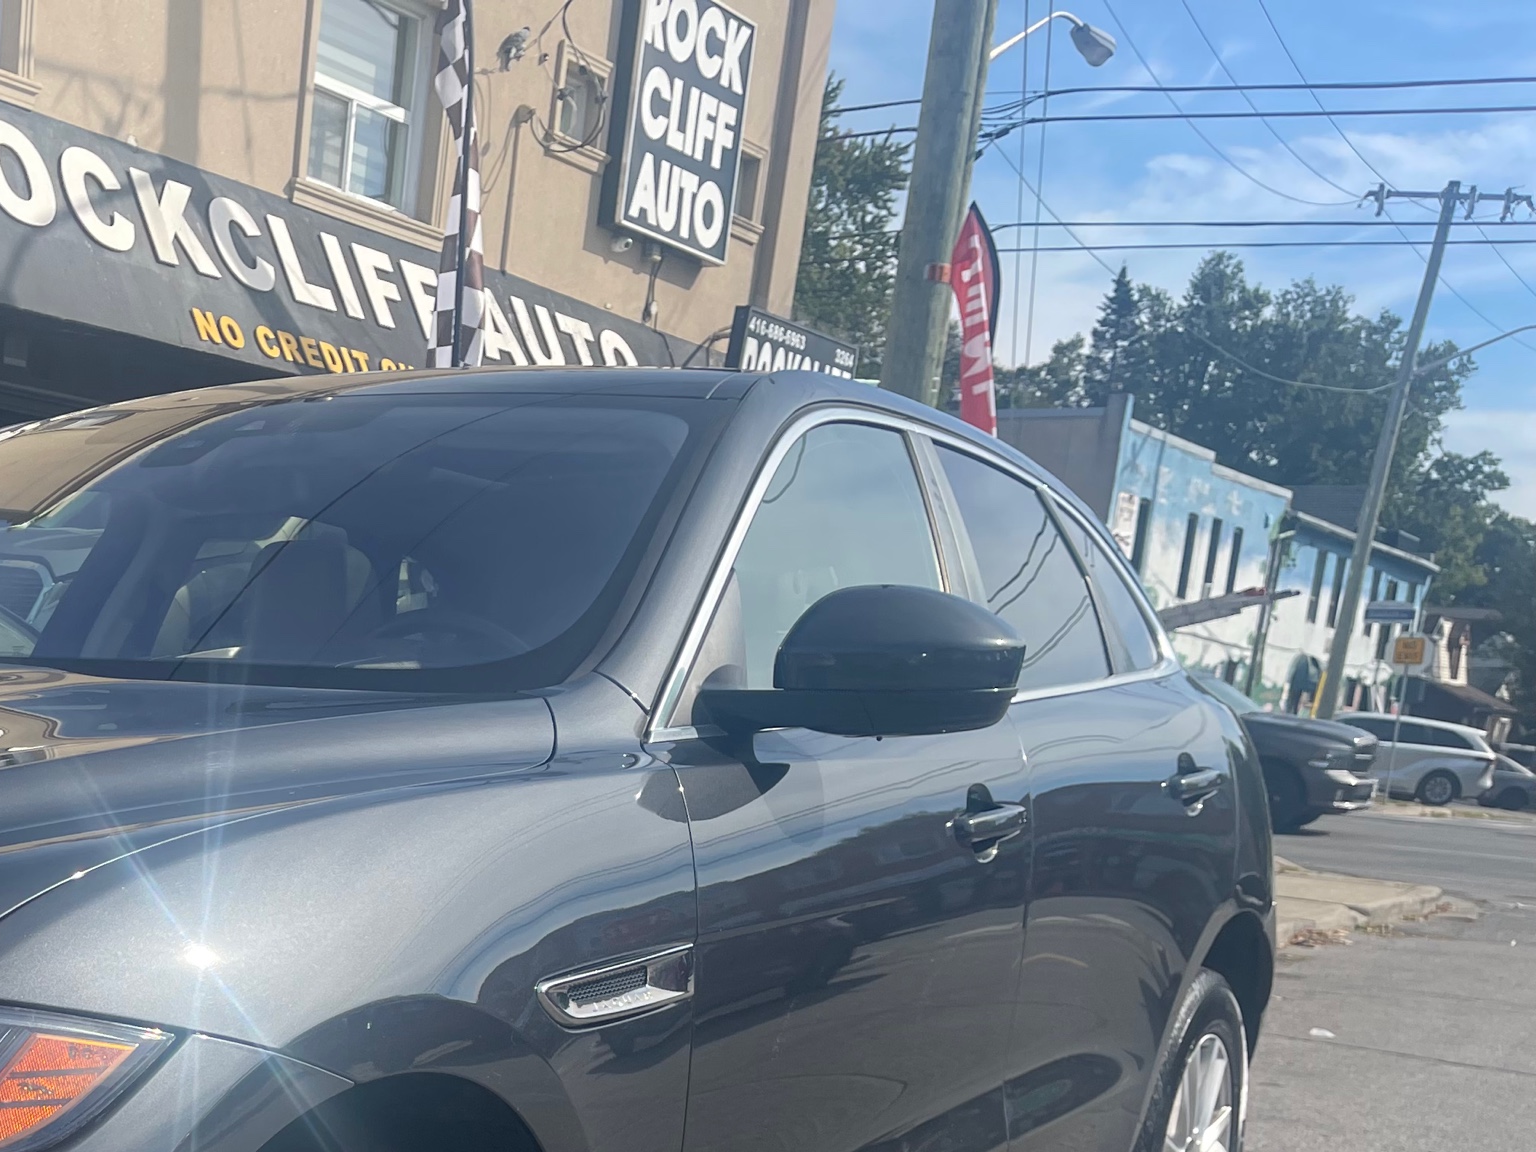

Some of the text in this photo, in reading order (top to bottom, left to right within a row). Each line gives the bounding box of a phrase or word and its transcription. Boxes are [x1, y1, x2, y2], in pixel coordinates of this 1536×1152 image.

[644, 0, 752, 95] ROCK
[640, 66, 738, 170] CLIFF
[627, 151, 725, 249] AUTO
[192, 306, 370, 374] NO CREDIT
[483, 287, 639, 366] AUTO
